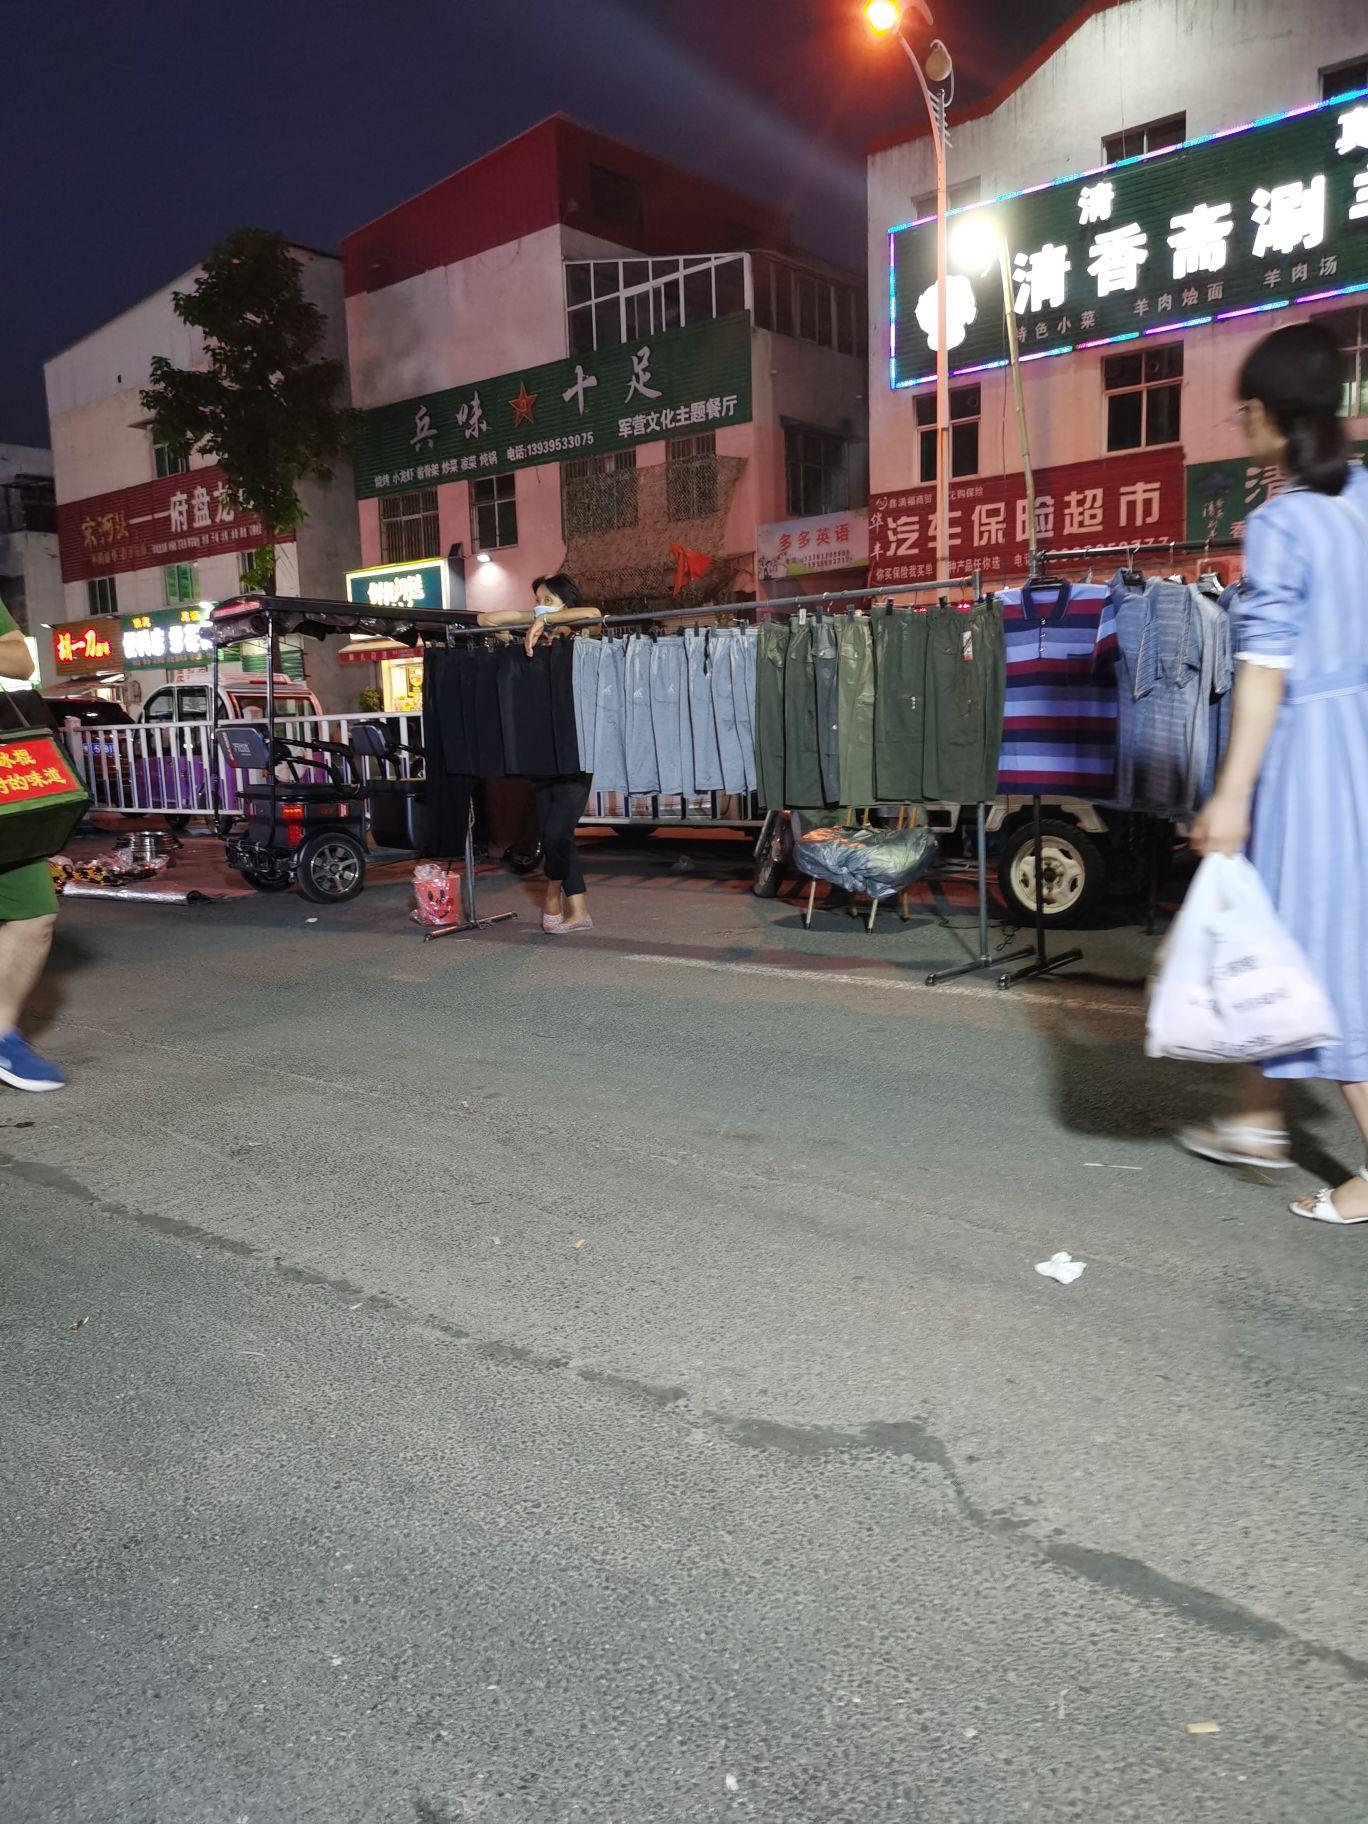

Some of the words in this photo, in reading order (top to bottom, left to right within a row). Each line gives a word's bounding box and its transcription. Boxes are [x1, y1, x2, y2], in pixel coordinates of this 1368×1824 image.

[1077, 182, 1114, 225] 清
[1016, 310, 1095, 343] 特色小菜
[1133, 281, 1225, 318] 羊肉烩面
[410, 388, 491, 453] 兵味
[562, 346, 663, 415] 十足
[617, 394, 738, 438] 军营文化主题餐厅
[778, 523, 850, 552] 多多英语
[887, 481, 1161, 556] 汽车保险超市
[876, 564, 933, 581] 你买保险我买单
